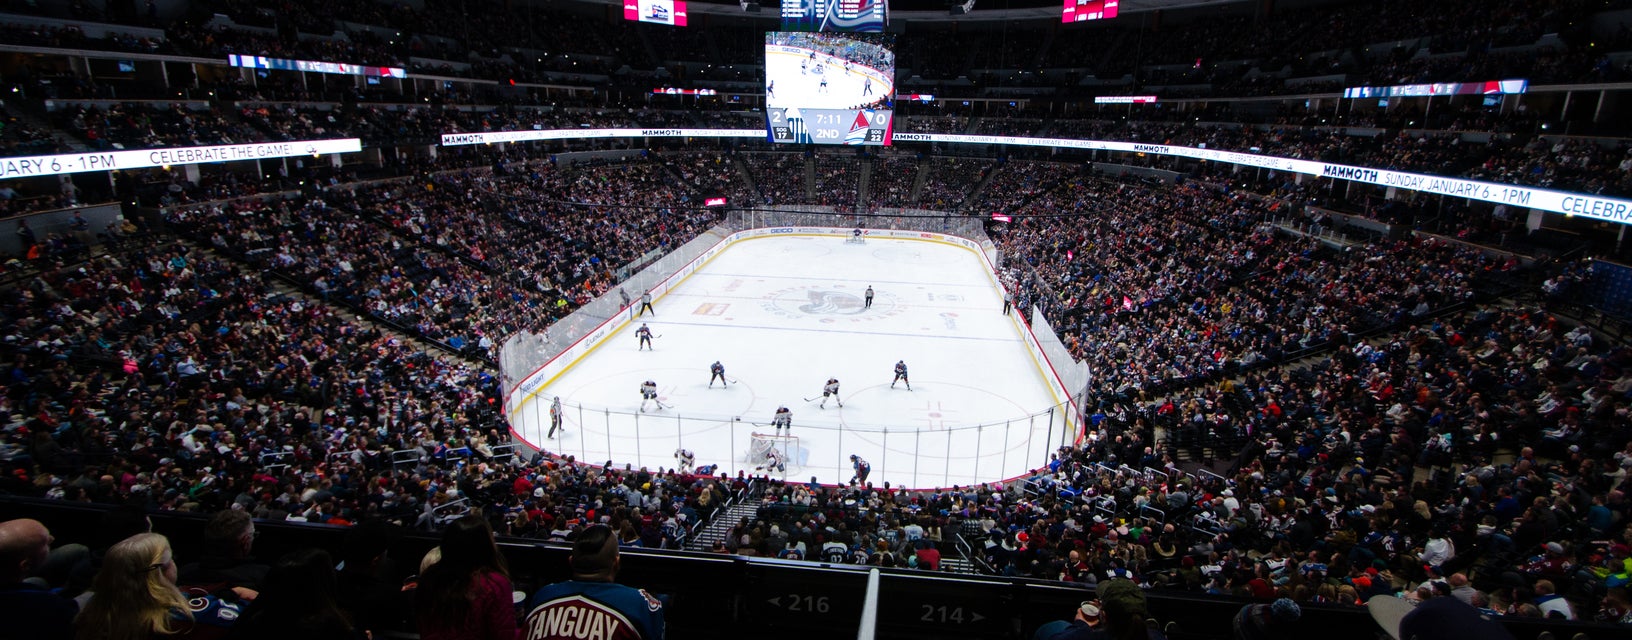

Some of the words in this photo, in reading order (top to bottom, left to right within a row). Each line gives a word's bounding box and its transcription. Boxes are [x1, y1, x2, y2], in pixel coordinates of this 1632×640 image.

[772, 111, 781, 123] 2
[817, 114, 841, 124] 7:11
[875, 114, 886, 125] 0
[443, 134, 484, 145] MAMMOTH
[816, 129, 839, 139] 2ND
[871, 134, 882, 142] 22
[1133, 144, 1169, 153] MAMMOTH
[51, 157, 62, 172] 6
[79, 154, 116, 172] 1PM
[150, 147, 227, 164] CELEBRATE
[230, 145, 254, 158] THE
[256, 143, 294, 157] GAME!
[1323, 164, 1379, 183] MAMMOTH
[1384, 172, 1425, 189] SUNDAY,
[1427, 177, 1480, 197] JANUARY
[1481, 185, 1490, 199] 6
[1502, 188, 1532, 205] 1PM
[788, 594, 830, 613] 216
[920, 604, 965, 624] 214
[526, 606, 619, 640] TANGUAY
